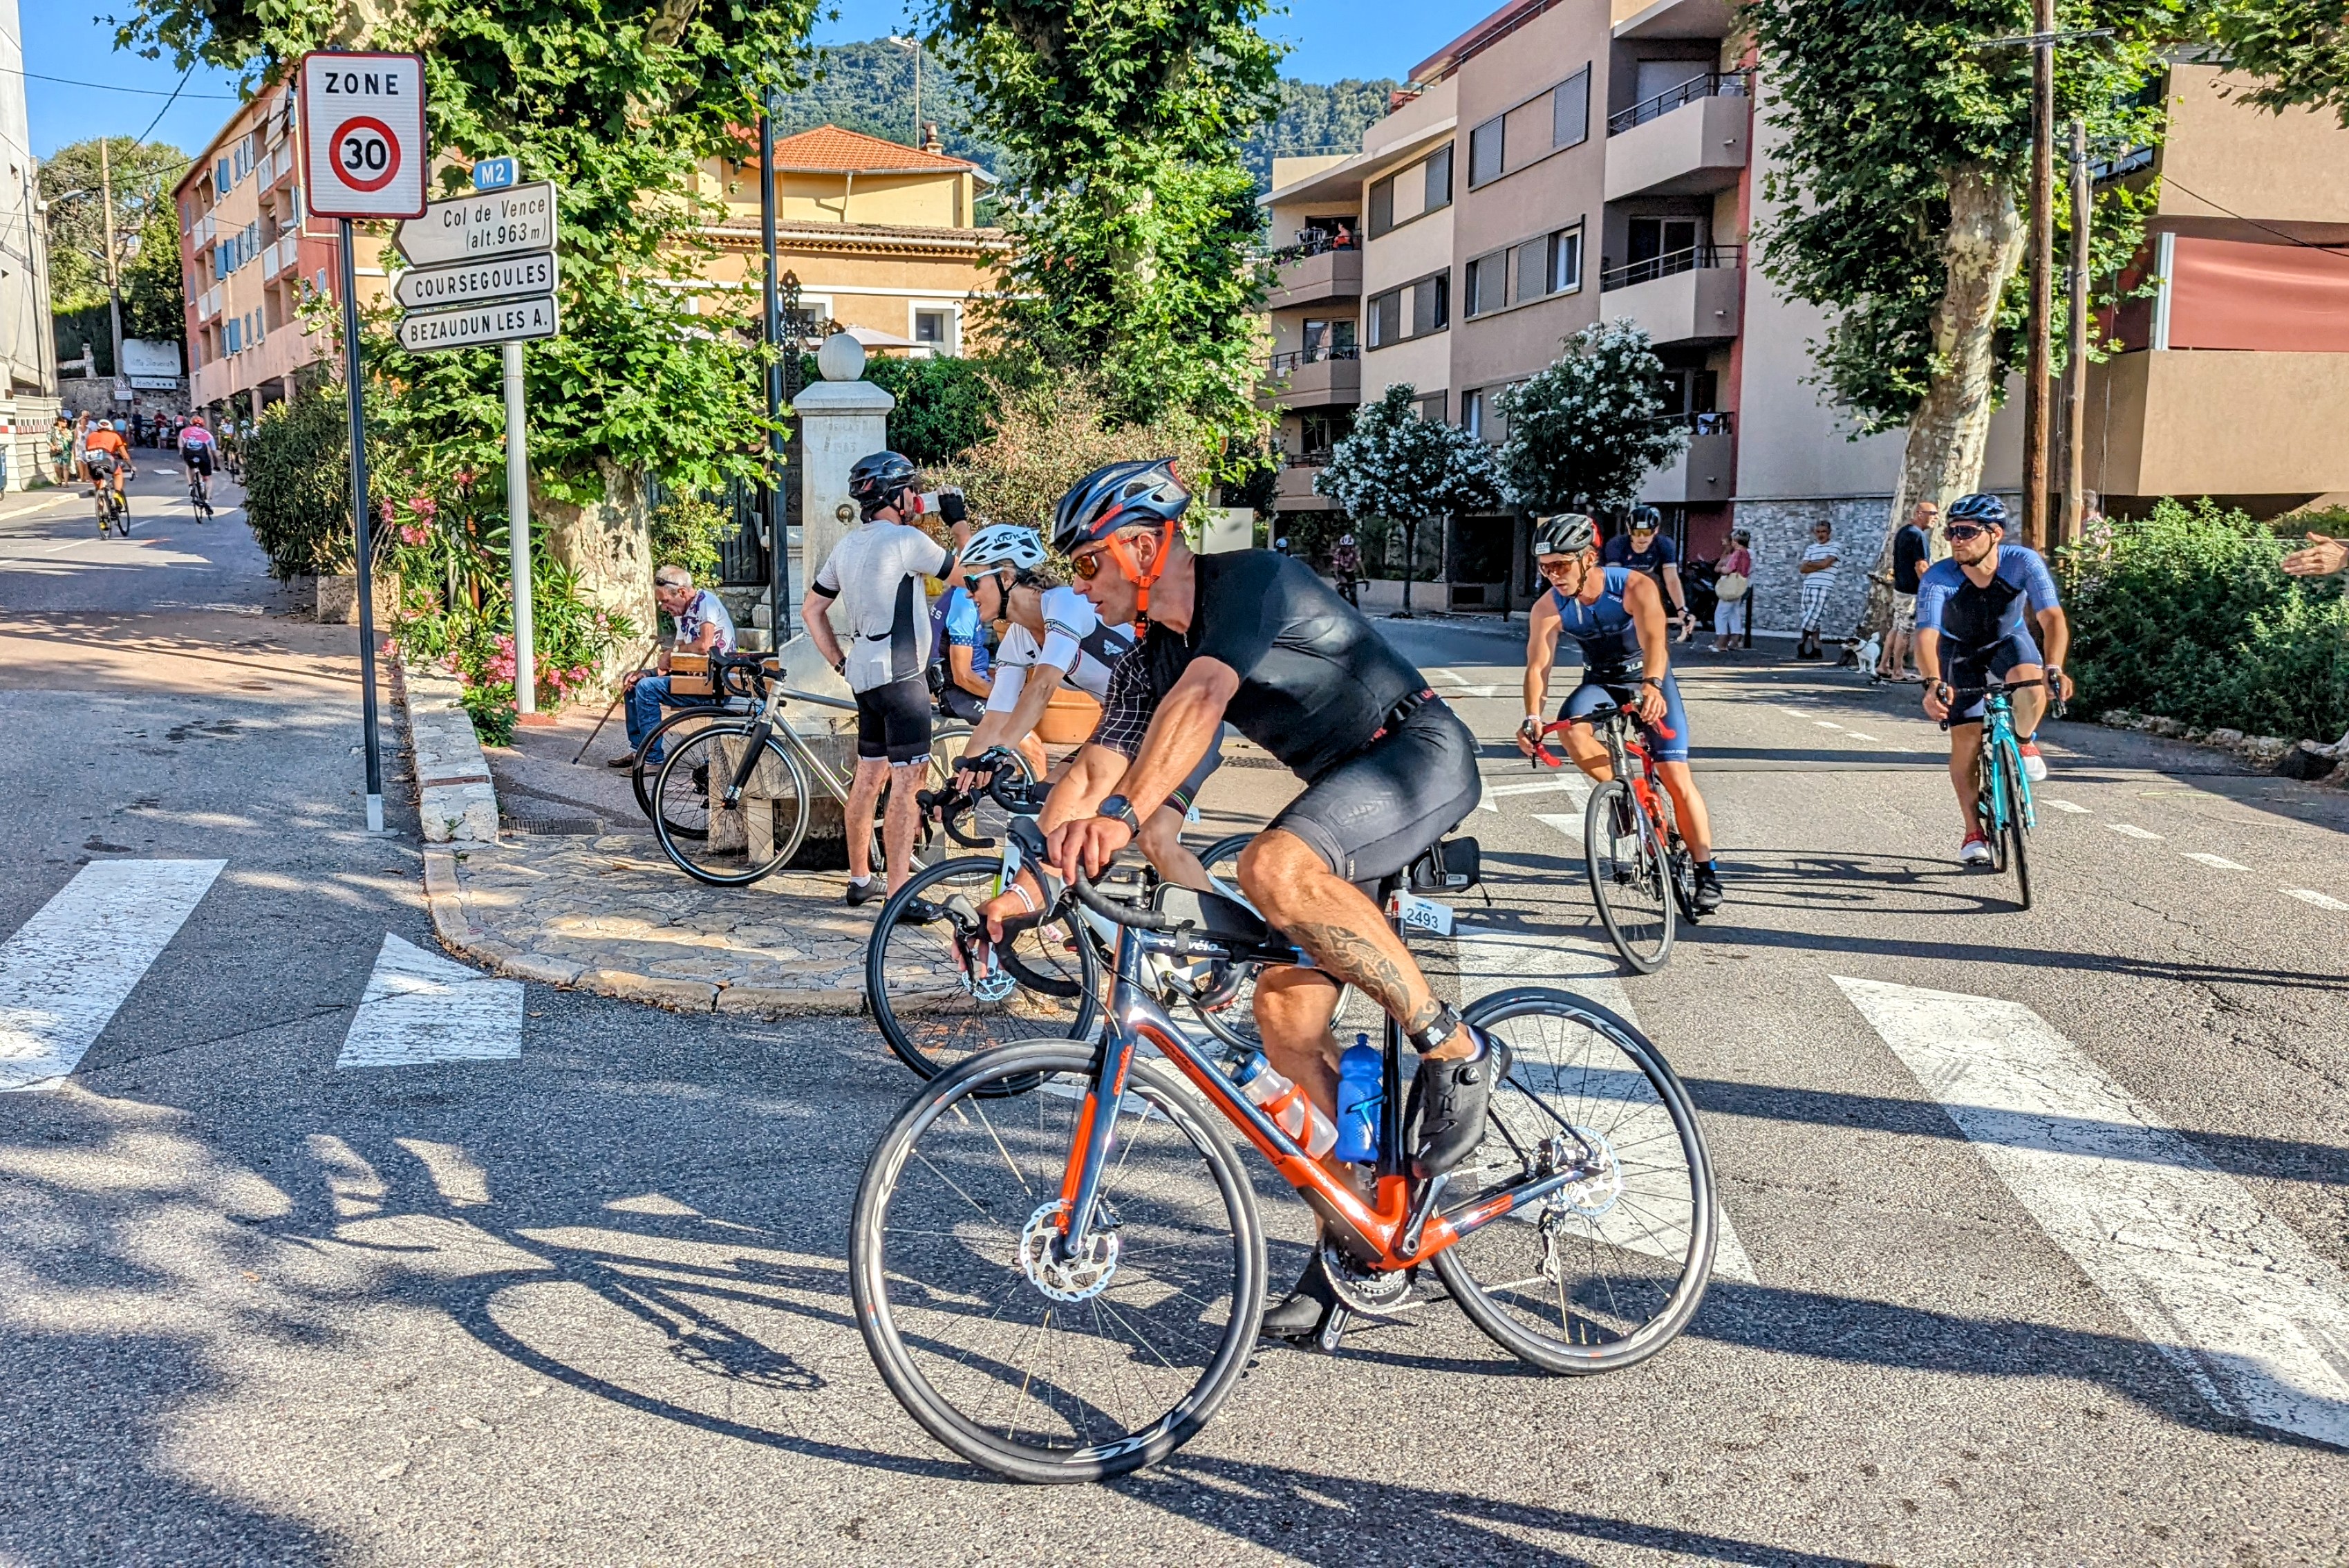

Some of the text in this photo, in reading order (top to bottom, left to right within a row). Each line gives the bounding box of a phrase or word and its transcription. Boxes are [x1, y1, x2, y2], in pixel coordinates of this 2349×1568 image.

[326, 73, 399, 95] ZONE
[344, 138, 386, 170] 30
[481, 163, 505, 185] M2
[444, 198, 545, 227] Col de Vence
[415, 263, 546, 298] COURSEGOULES
[411, 308, 548, 342] BEZAUDUN LES A.
[994, 532, 1020, 543] KASK
[1406, 908, 1439, 929] 2493
[1159, 938, 1218, 951] cevélo
